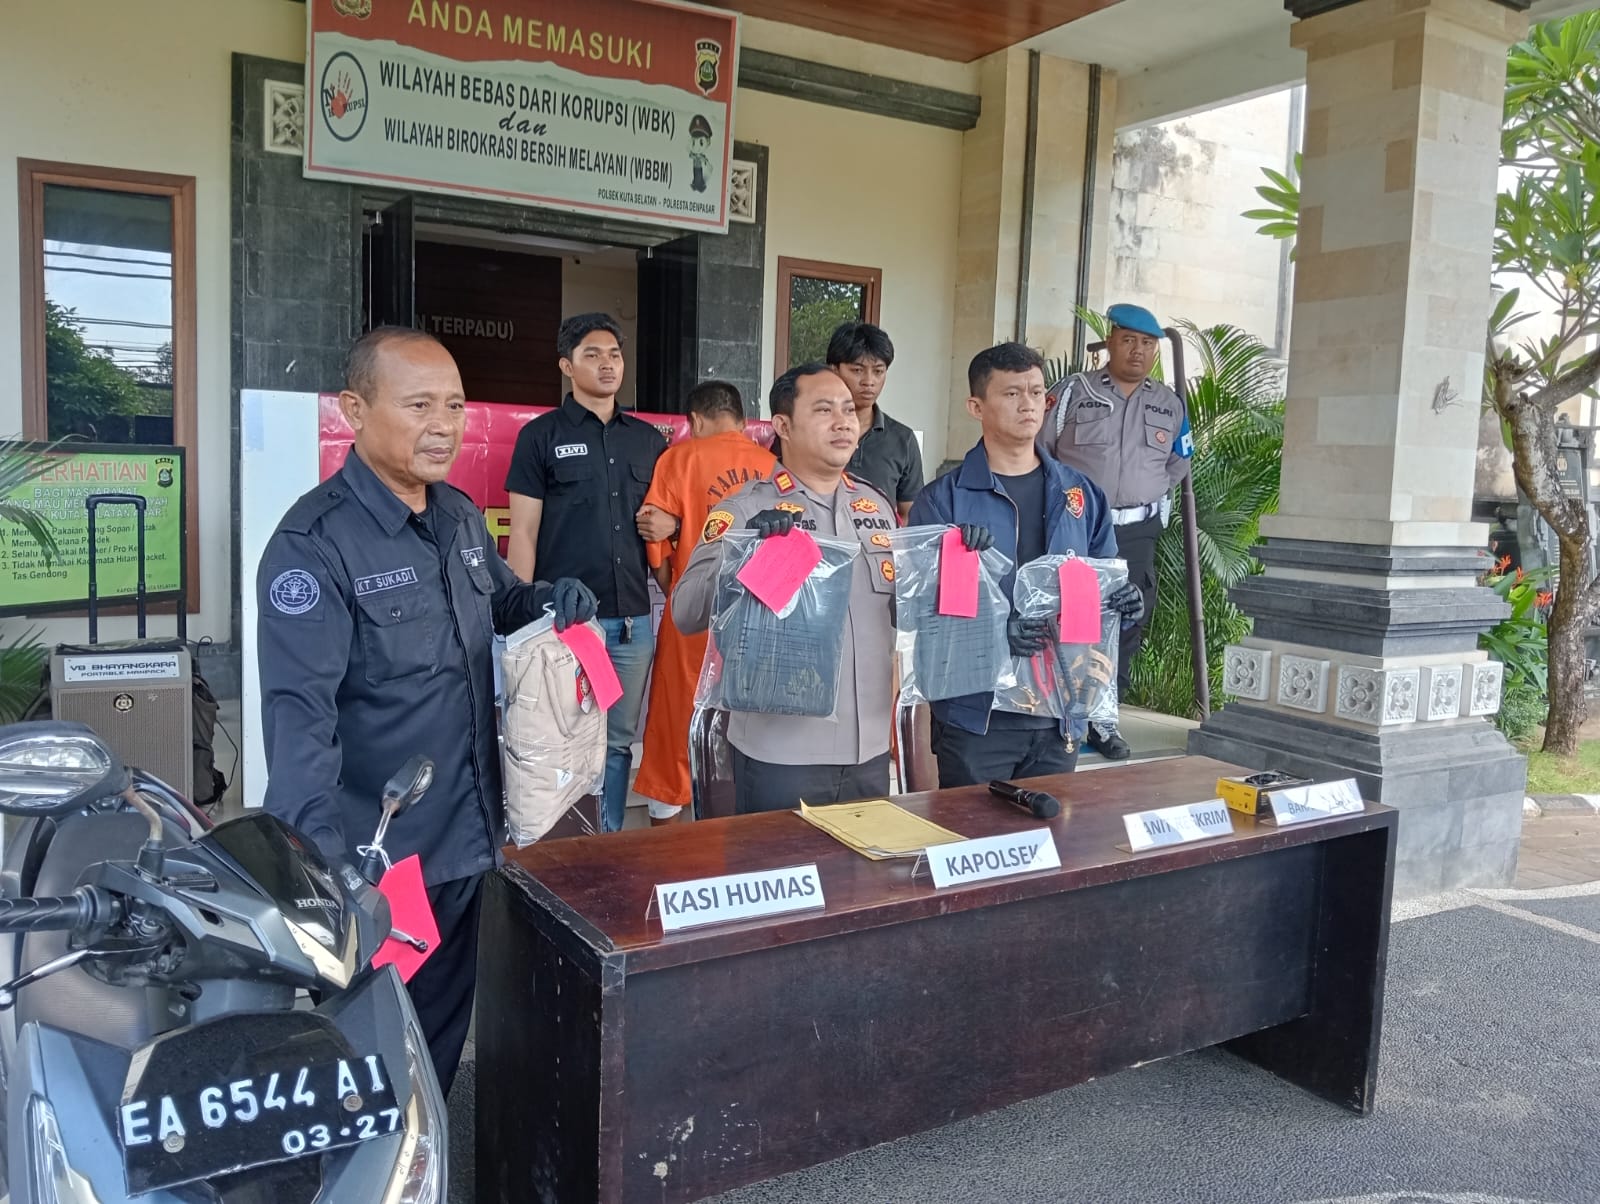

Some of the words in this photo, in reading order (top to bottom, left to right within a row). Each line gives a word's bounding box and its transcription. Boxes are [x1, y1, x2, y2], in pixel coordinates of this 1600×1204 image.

[408, 0, 493, 39] ANDA
[503, 15, 651, 69] MEMASUKI
[380, 60, 456, 98] WILAYAH
[460, 75, 515, 108] BEBAS
[519, 85, 557, 116] DARI
[561, 92, 628, 128] KORUPSI
[632, 104, 675, 141] (WBK)
[498, 110, 547, 136] dan
[384, 117, 443, 149] WILAYAH
[447, 127, 518, 160] BIROKRASI
[520, 138, 567, 168] BERSIH
[569, 147, 627, 177] MELAYANI
[630, 156, 673, 189] (WBBM)
[598, 188, 619, 201] POLSEK
[620, 191, 633, 203] KUTA
[634, 194, 657, 207] SELATAN
[663, 198, 689, 211] POLRESTA
[689, 201, 715, 214] DENPASAR
[432, 316, 514, 341] TERPADU)
[1145, 404, 1173, 417] POLRI
[31, 461, 147, 482] ERHATIAN
[34, 488, 63, 498] BAGI
[34, 500, 60, 509] MAU
[107, 525, 131, 534] Sopan
[853, 517, 892, 531] POLRI
[12, 550, 38, 558] Selalu
[12, 560, 35, 569] Tidak
[12, 571, 27, 580] Tas
[30, 570, 68, 579] Gendong
[357, 579, 370, 592] KT
[376, 571, 413, 588] SUKADI
[92, 661, 176, 671] BHAYANGKARA
[946, 844, 1044, 877] KAPOLSEK
[295, 898, 341, 911] HONDA
[663, 887, 719, 916] KASI
[726, 875, 816, 906] HUMAS
[121, 1096, 186, 1146] EA
[200, 1067, 316, 1128] 6544
[338, 1055, 385, 1100] AI
